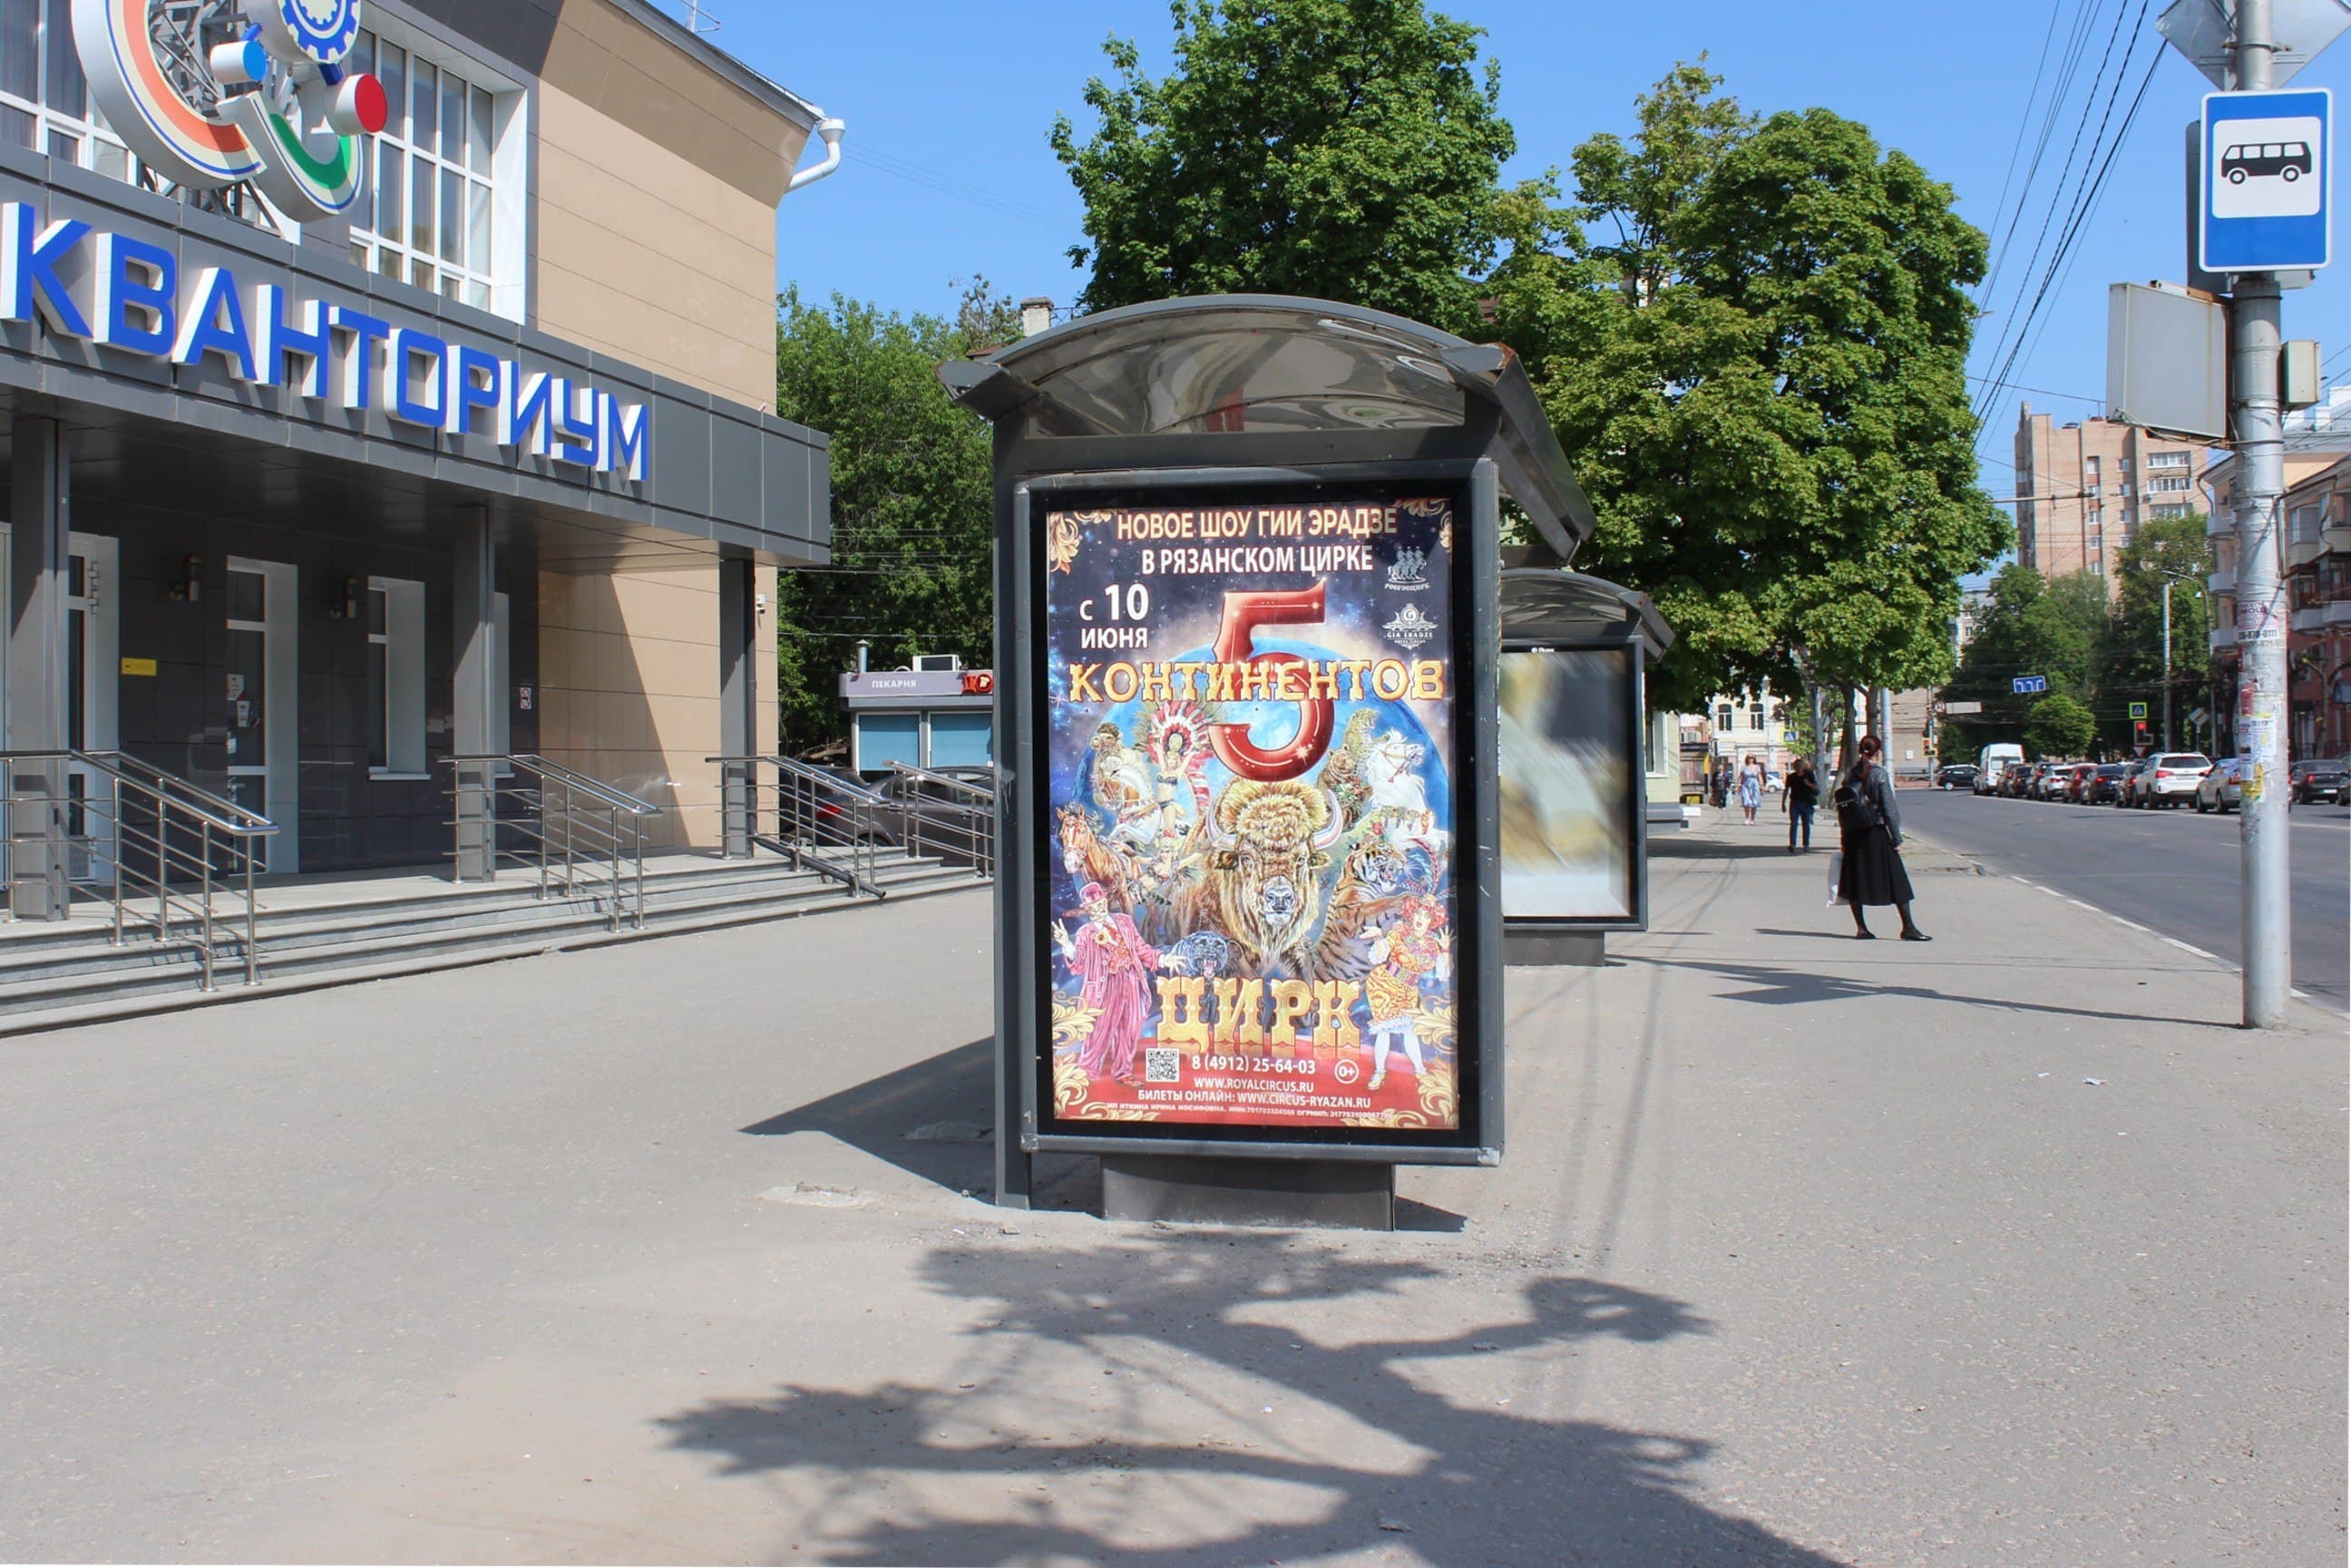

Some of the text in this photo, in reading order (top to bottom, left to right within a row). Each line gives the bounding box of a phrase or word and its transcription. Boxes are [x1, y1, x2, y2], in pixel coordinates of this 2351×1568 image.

[1, 201, 649, 482] КВАНТОРИУМ
[1117, 508, 1397, 540] НОВОЕ ШОУ ГИИ ЭРАДЗЕ
[1142, 545, 1373, 576] В РЯЗАНСКОМ ЦИРКЕ
[1105, 583, 1149, 621] 10
[1080, 627, 1148, 649] ИЮНЯ
[872, 679, 916, 689] ПЕКАРНЯ
[1068, 658, 1446, 703] КОНТИНЕНТОВ
[1209, 577, 1335, 782] 5
[1156, 975, 1361, 1054] ЦИРК
[1192, 1055, 1315, 1075] 8 (4912) 25-64-03
[1338, 1066, 1356, 1076] 0+
[1138, 1089, 1371, 1108] БИЛЕТЫ ОНЛАЙН: WWW.CIRCUS-RYAZAN.RU
[1194, 1077, 1313, 1094] WWW.ROYALCIRCUS.RU
